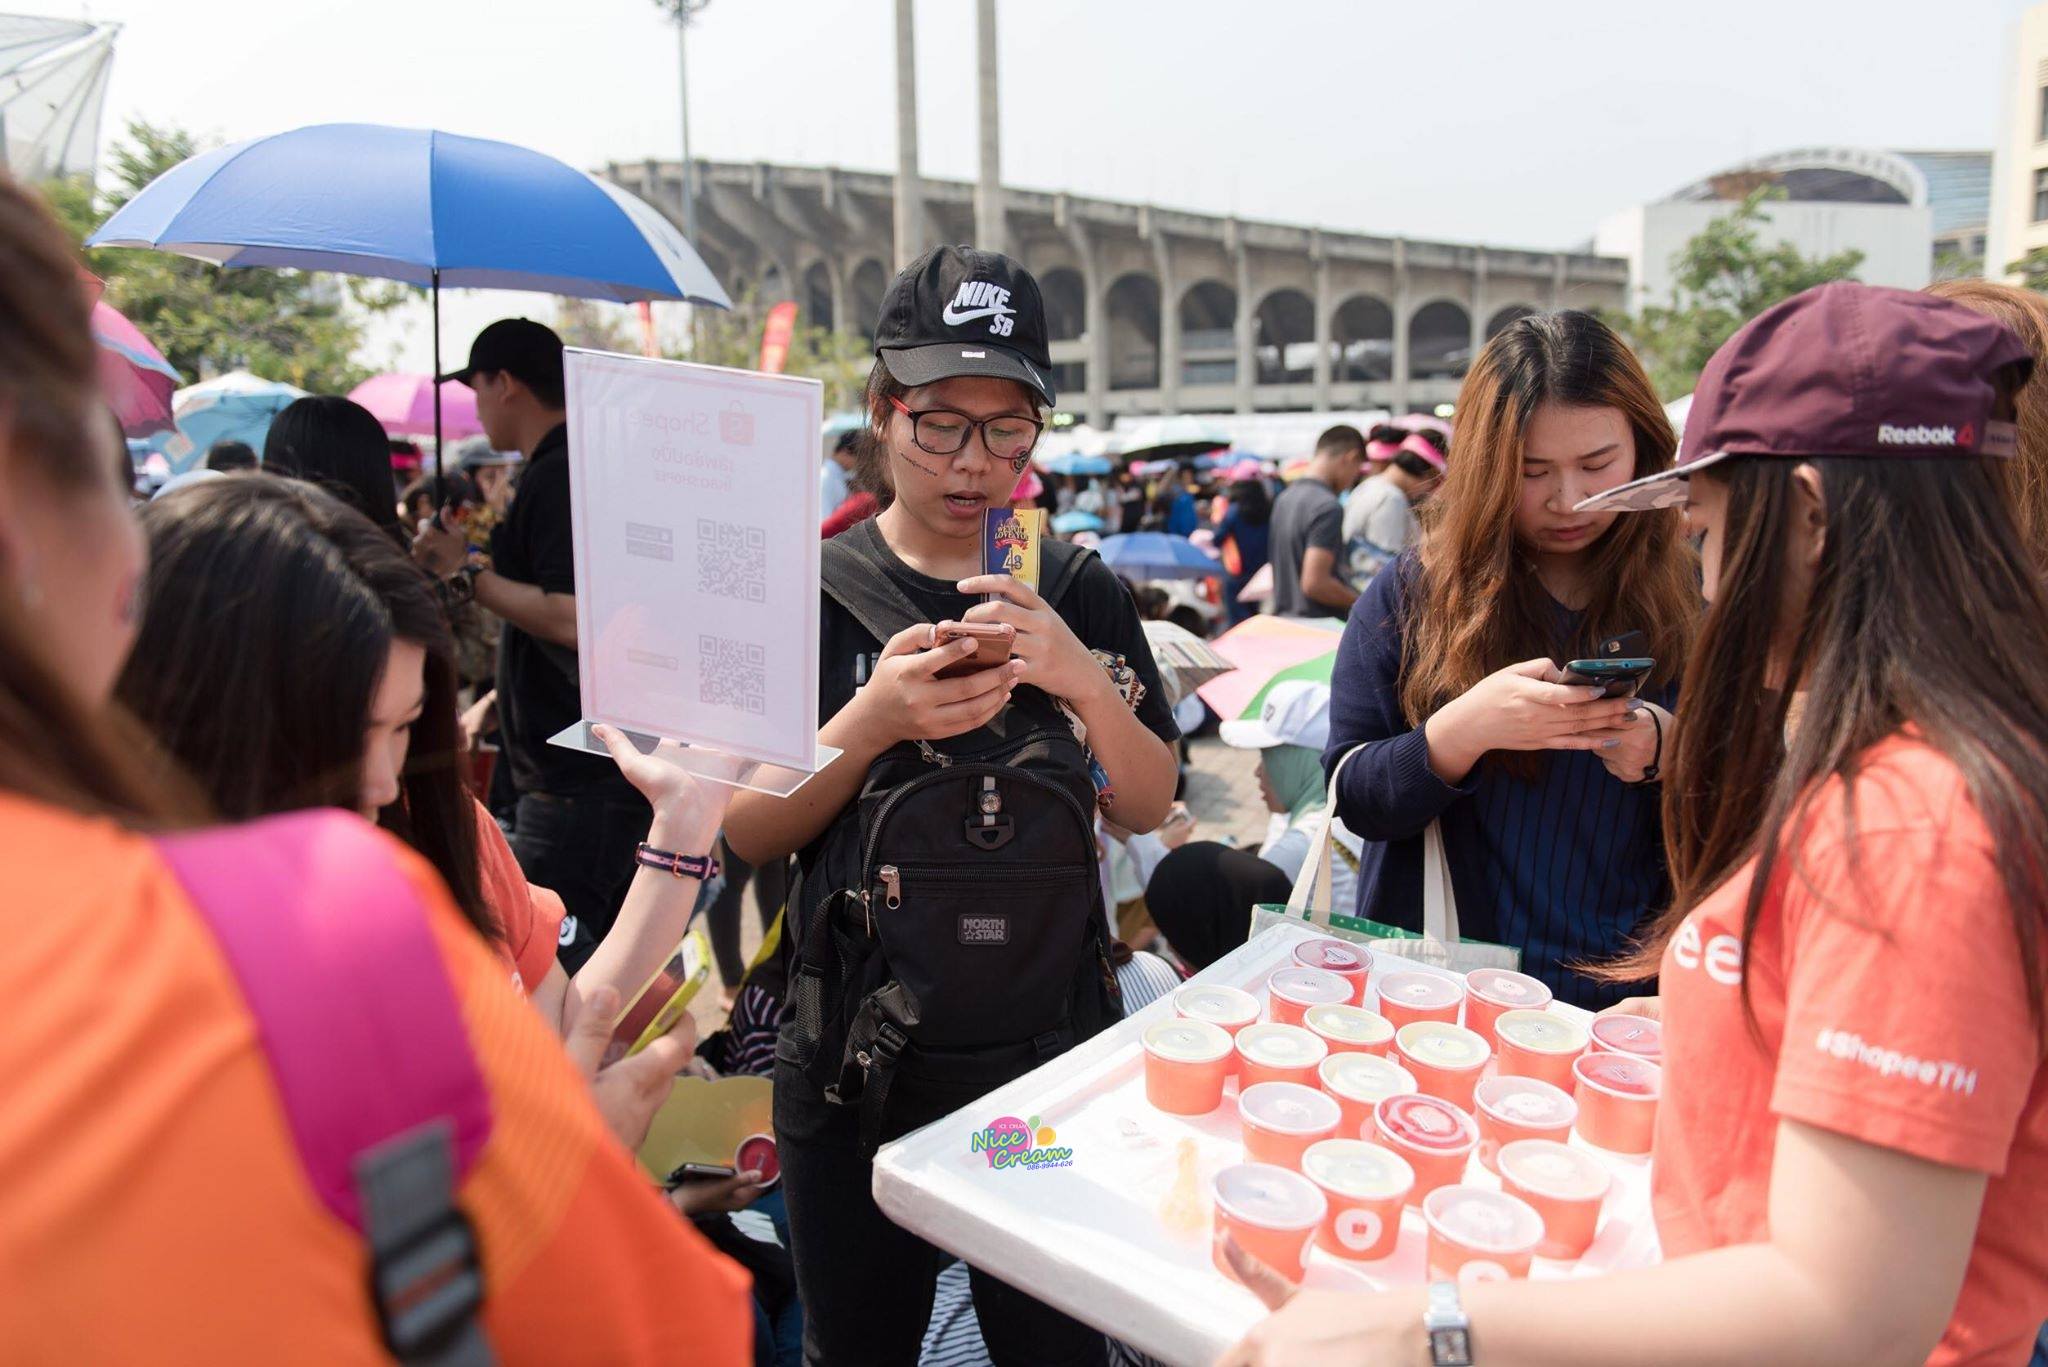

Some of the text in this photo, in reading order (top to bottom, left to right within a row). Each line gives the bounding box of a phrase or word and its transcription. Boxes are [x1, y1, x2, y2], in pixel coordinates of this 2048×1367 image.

[953, 281, 1011, 308] NIKE
[989, 313, 1014, 337] SB
[1877, 423, 1956, 445] Reebok
[963, 918, 1005, 930] NORTH
[975, 929, 1004, 940] STAR
[1815, 1028, 1977, 1096] #ShopeeTH
